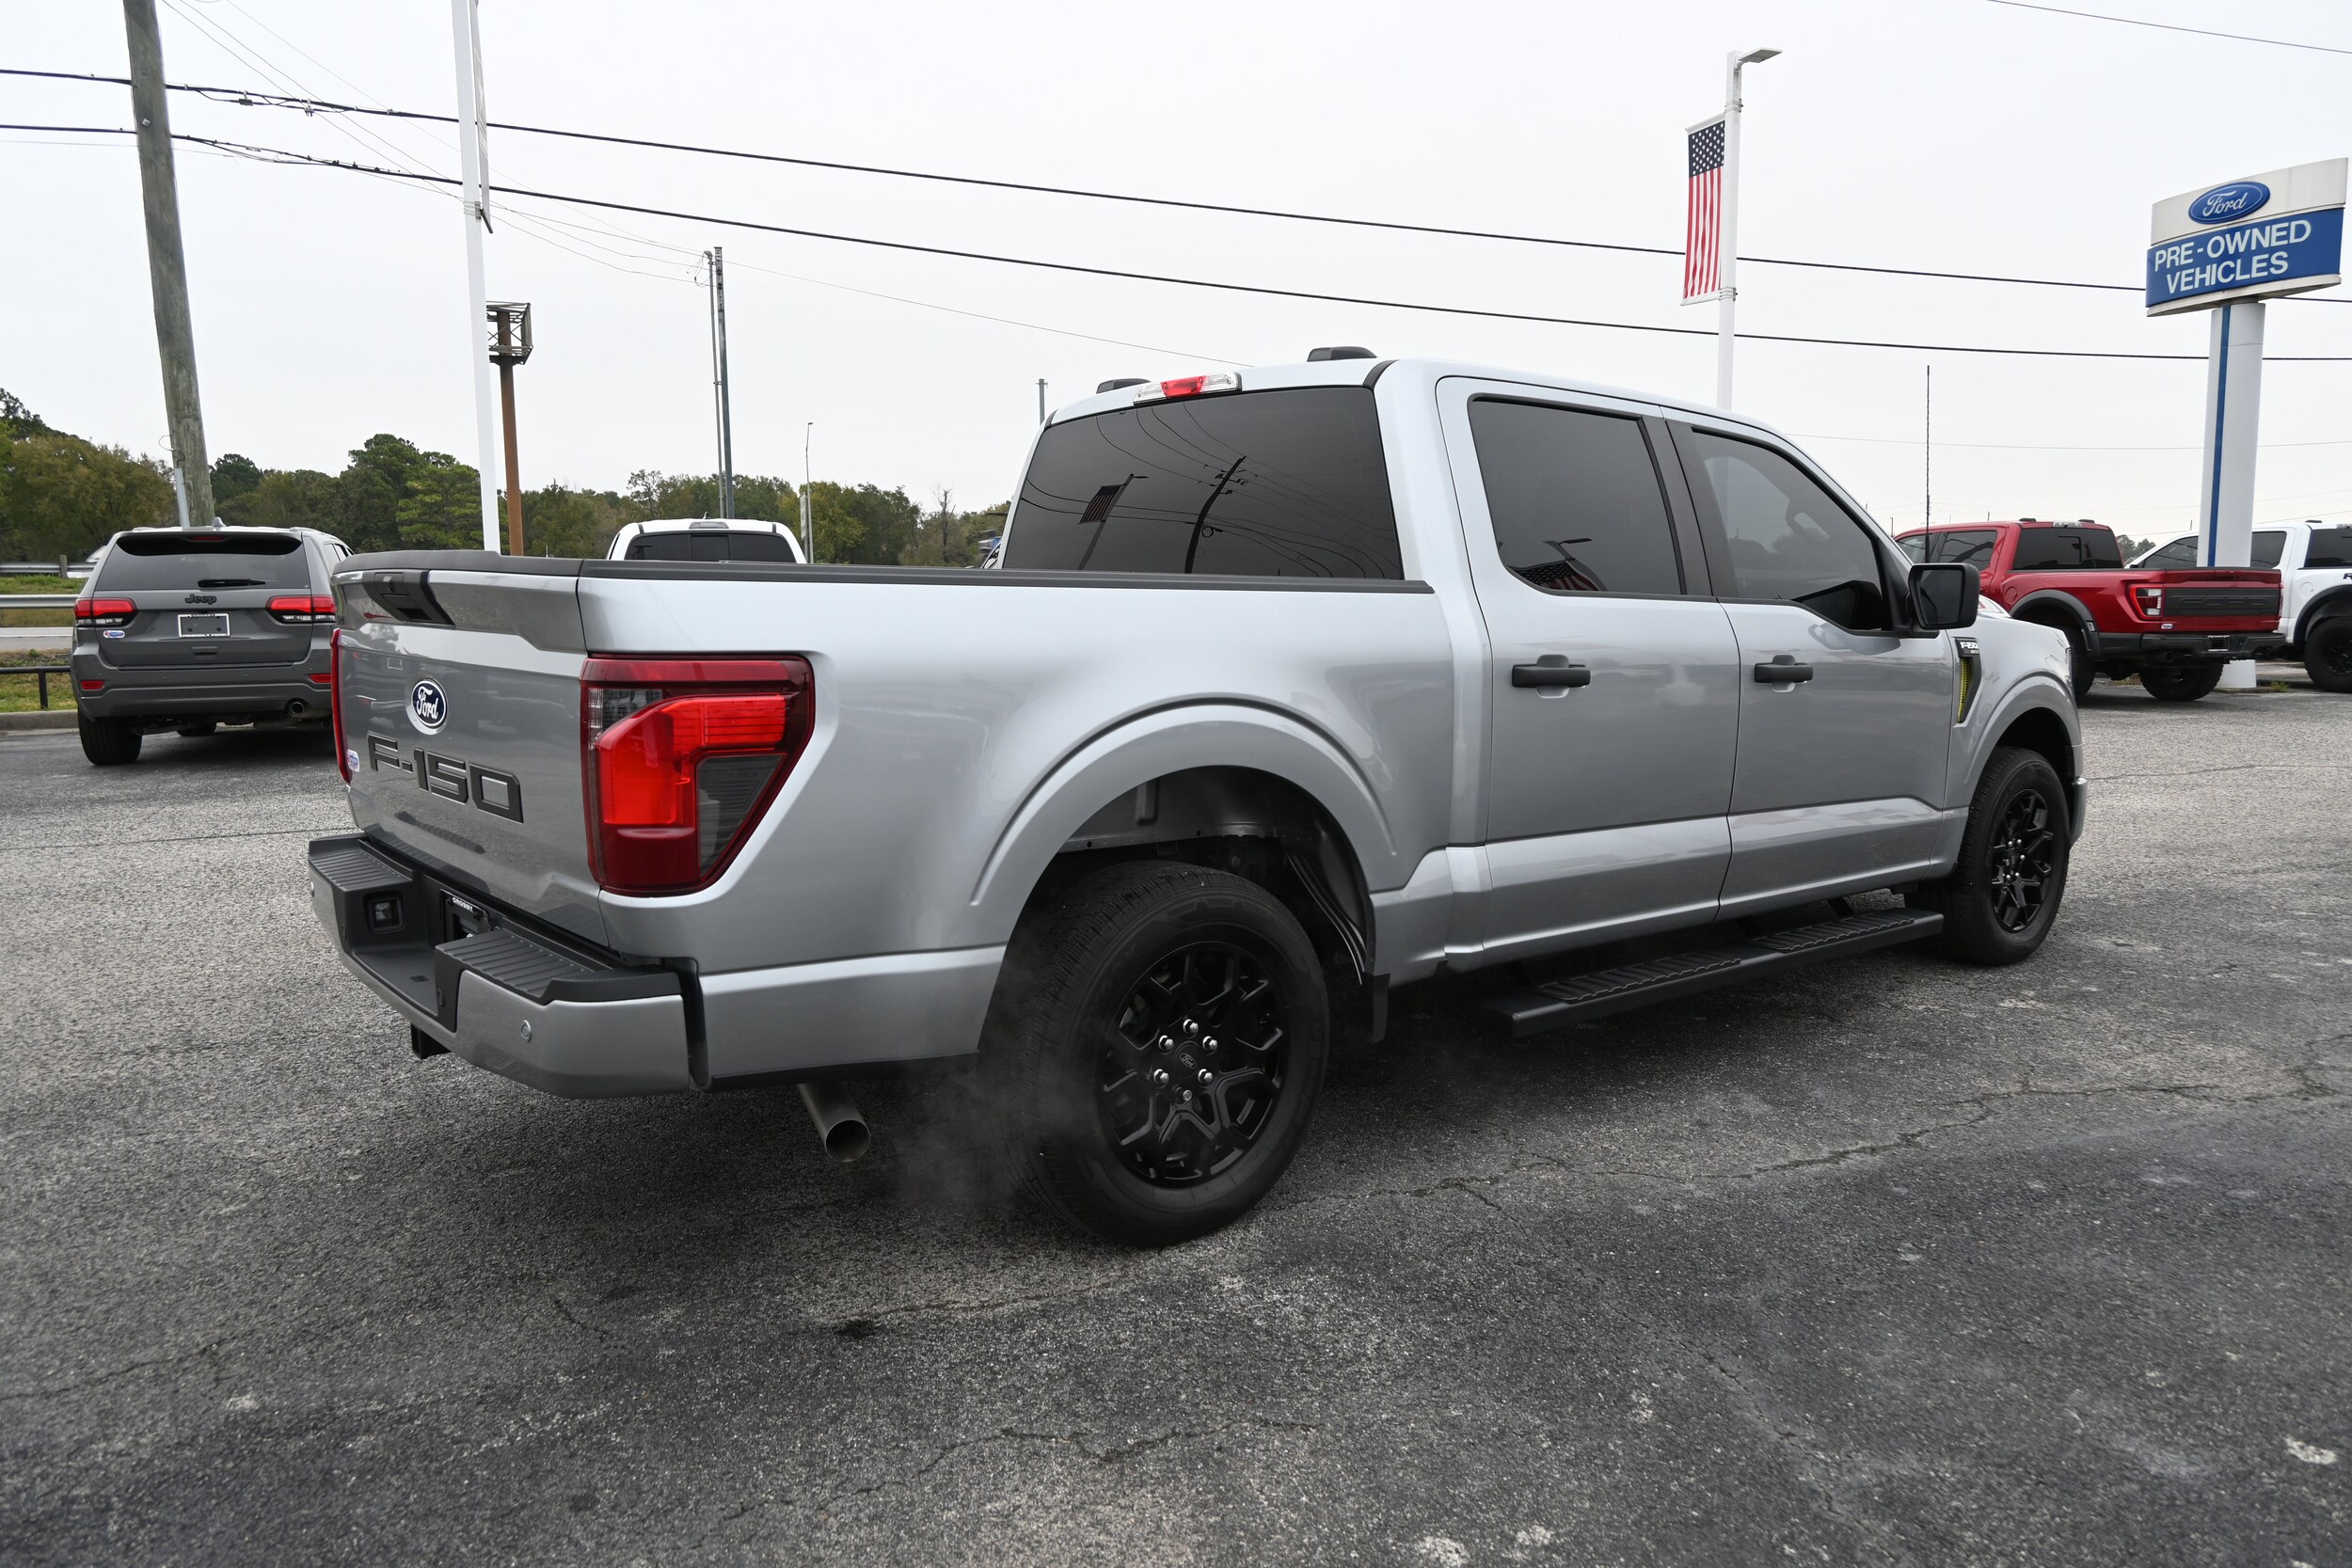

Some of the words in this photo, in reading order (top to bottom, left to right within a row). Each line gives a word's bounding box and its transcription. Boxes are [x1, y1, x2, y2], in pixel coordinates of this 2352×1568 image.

[2201, 190, 2249, 217] Ford
[2154, 219, 2312, 272] PRE-OWNED
[2166, 251, 2289, 294] VEHICLES
[184, 594, 217, 606] Jeep
[416, 685, 440, 721] Ford
[367, 731, 524, 824] F-150
